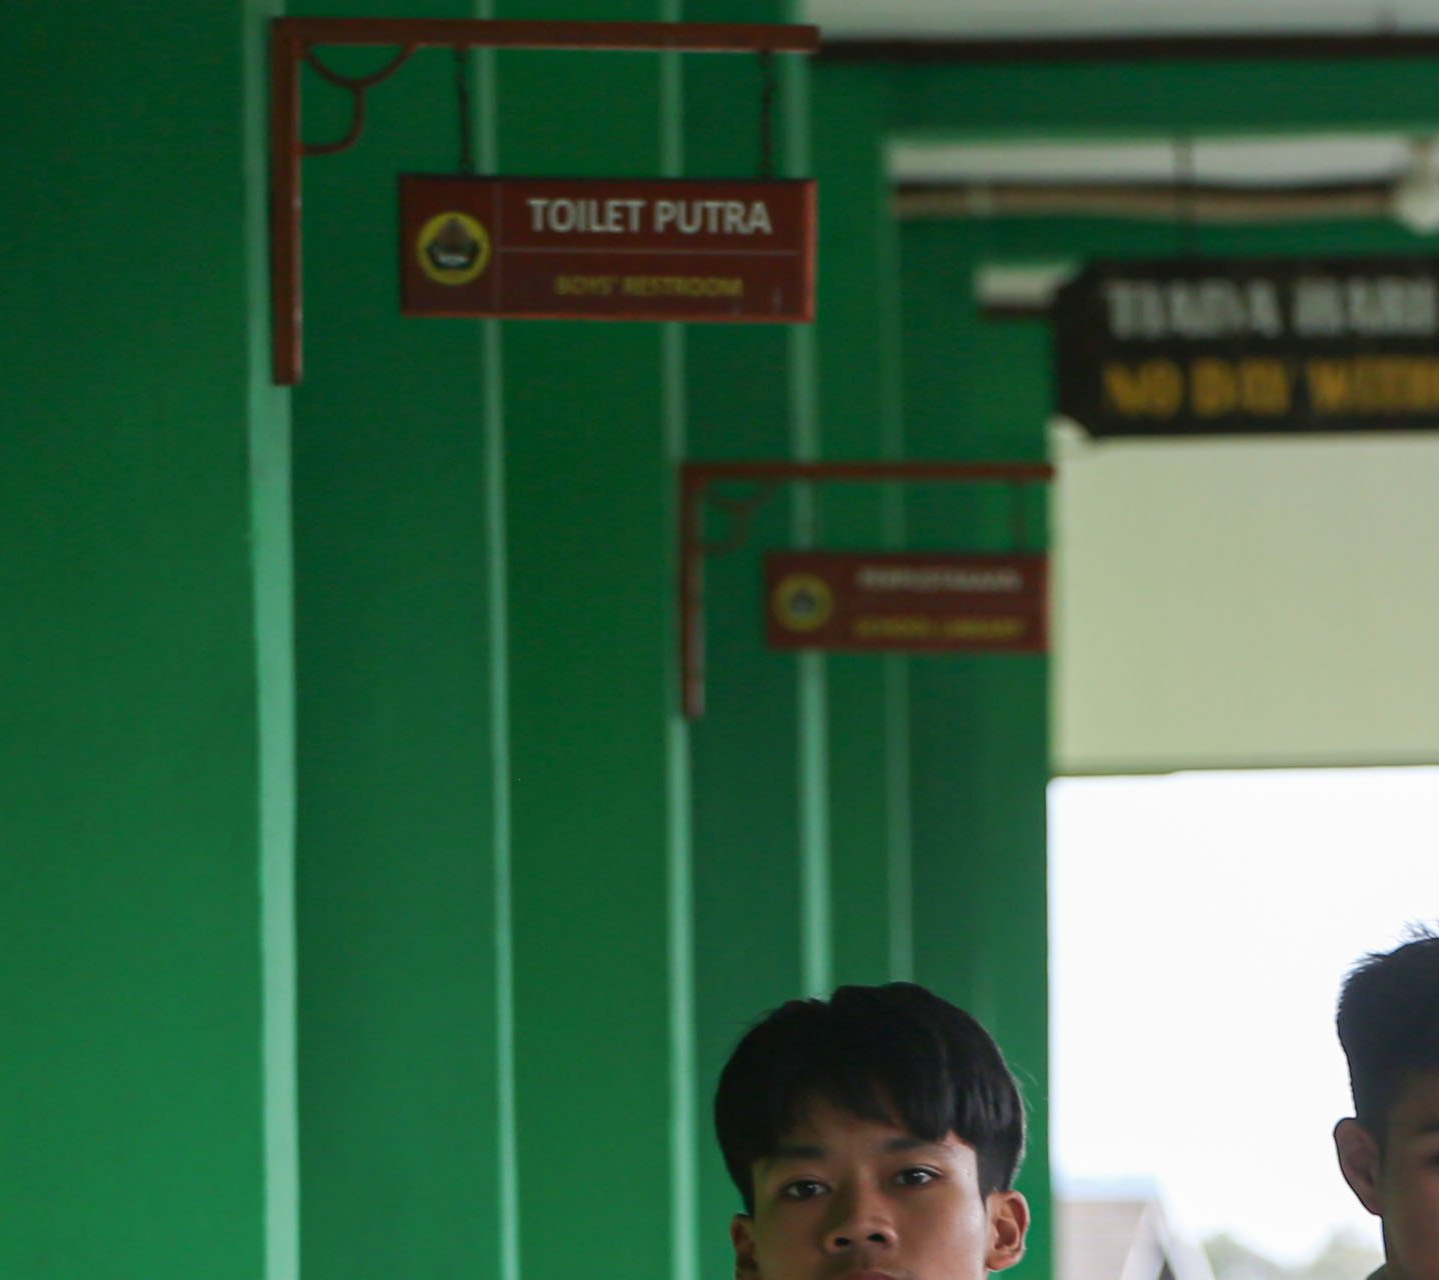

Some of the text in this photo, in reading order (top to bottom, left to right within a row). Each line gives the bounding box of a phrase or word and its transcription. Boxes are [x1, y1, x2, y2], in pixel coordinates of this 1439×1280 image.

[525, 198, 773, 235] TOILET PUTRA
[1103, 282, 1280, 338] TIADA
[1295, 280, 1439, 336] HARI
